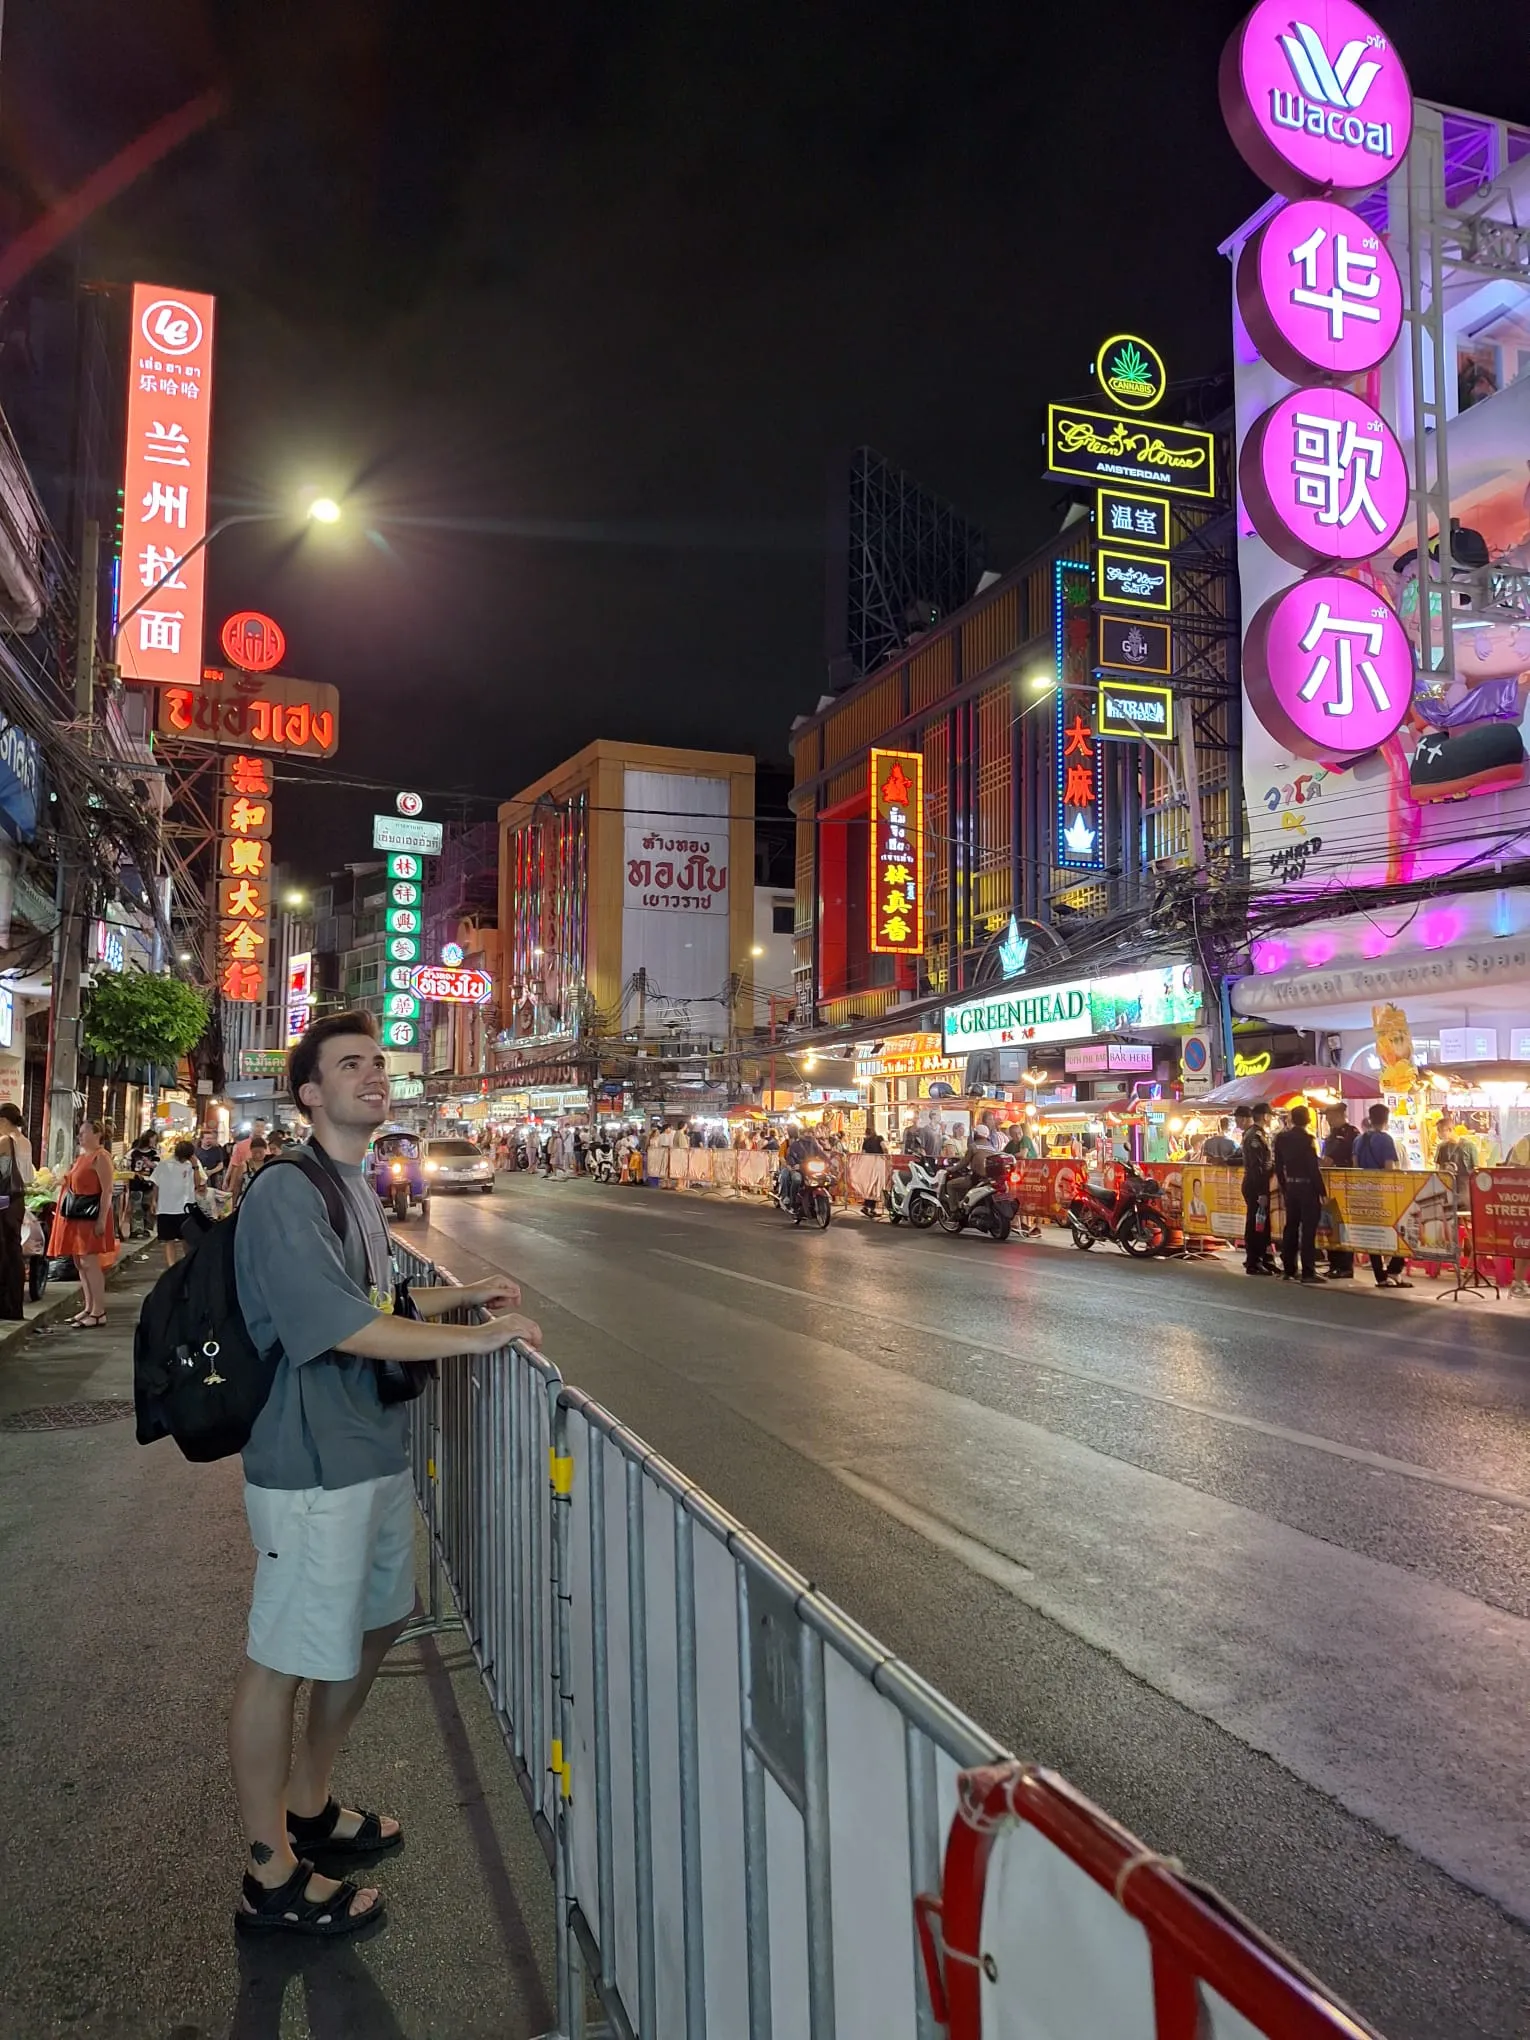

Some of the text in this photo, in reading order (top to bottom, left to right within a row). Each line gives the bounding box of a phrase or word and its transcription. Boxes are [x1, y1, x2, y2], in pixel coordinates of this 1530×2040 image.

[139, 374, 200, 399] 乐哈哈
[1112, 379, 1152, 394] CANNABIS
[1057, 419, 1205, 468] Green House
[1096, 462, 1171, 483] AMSTERDAM
[1111, 502, 1157, 535] 温室
[137, 420, 190, 655] 兰州拉面
[1064, 714, 1095, 808] 大麻
[641, 832, 710, 854] ห้างทอง
[626, 854, 727, 893] ทองใบ
[642, 894, 712, 910] เยาวราช
[419, 973, 484, 998] ทองใบ
[959, 989, 1084, 1035] GREENHEAD
[1110, 1052, 1151, 1062] BAR HERE
[1497, 1192, 1530, 1203] YAOW
